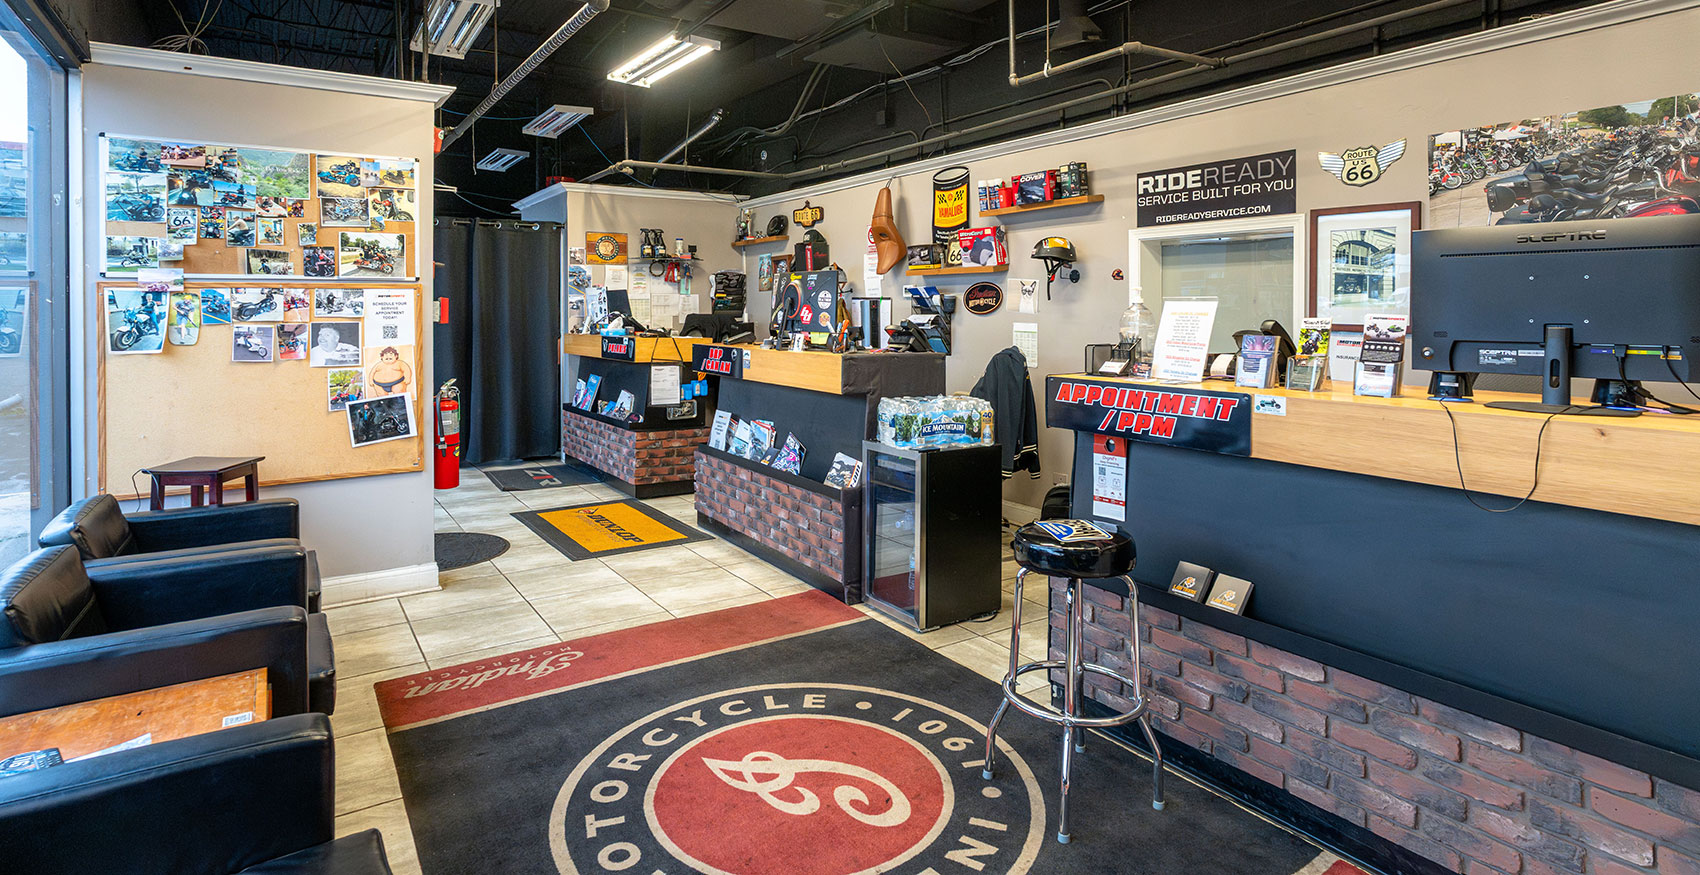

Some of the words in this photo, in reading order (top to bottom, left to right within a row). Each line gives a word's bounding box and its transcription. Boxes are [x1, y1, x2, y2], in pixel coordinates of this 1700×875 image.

[1347, 150, 1373, 159] ROUTE
[1019, 173, 1045, 183] COVER
[1138, 155, 1293, 195] RIDEREADY
[1346, 164, 1373, 181] 66
[1138, 191, 1189, 207] SERVICE
[1192, 187, 1230, 201] BUILT
[1233, 183, 1261, 196] FOR
[1264, 178, 1294, 192] YOU
[938, 202, 964, 218] YAMALUBE
[1156, 205, 1271, 223] RIDEREADYSERVICE.COM
[173, 216, 191, 227] 66
[1516, 229, 1607, 244] SCEPTRE
[950, 250, 962, 262] 66
[708, 347, 724, 359] BRP
[1056, 382, 1241, 422] APPOINTMENT
[922, 425, 931, 433] ICE
[932, 424, 964, 432] MOUNTAIN
[587, 514, 645, 542] DUNLOP
[407, 646, 572, 685] MOTORCYCLE
[404, 651, 584, 698] Indian
[585, 693, 826, 875] OTORCYCLE
